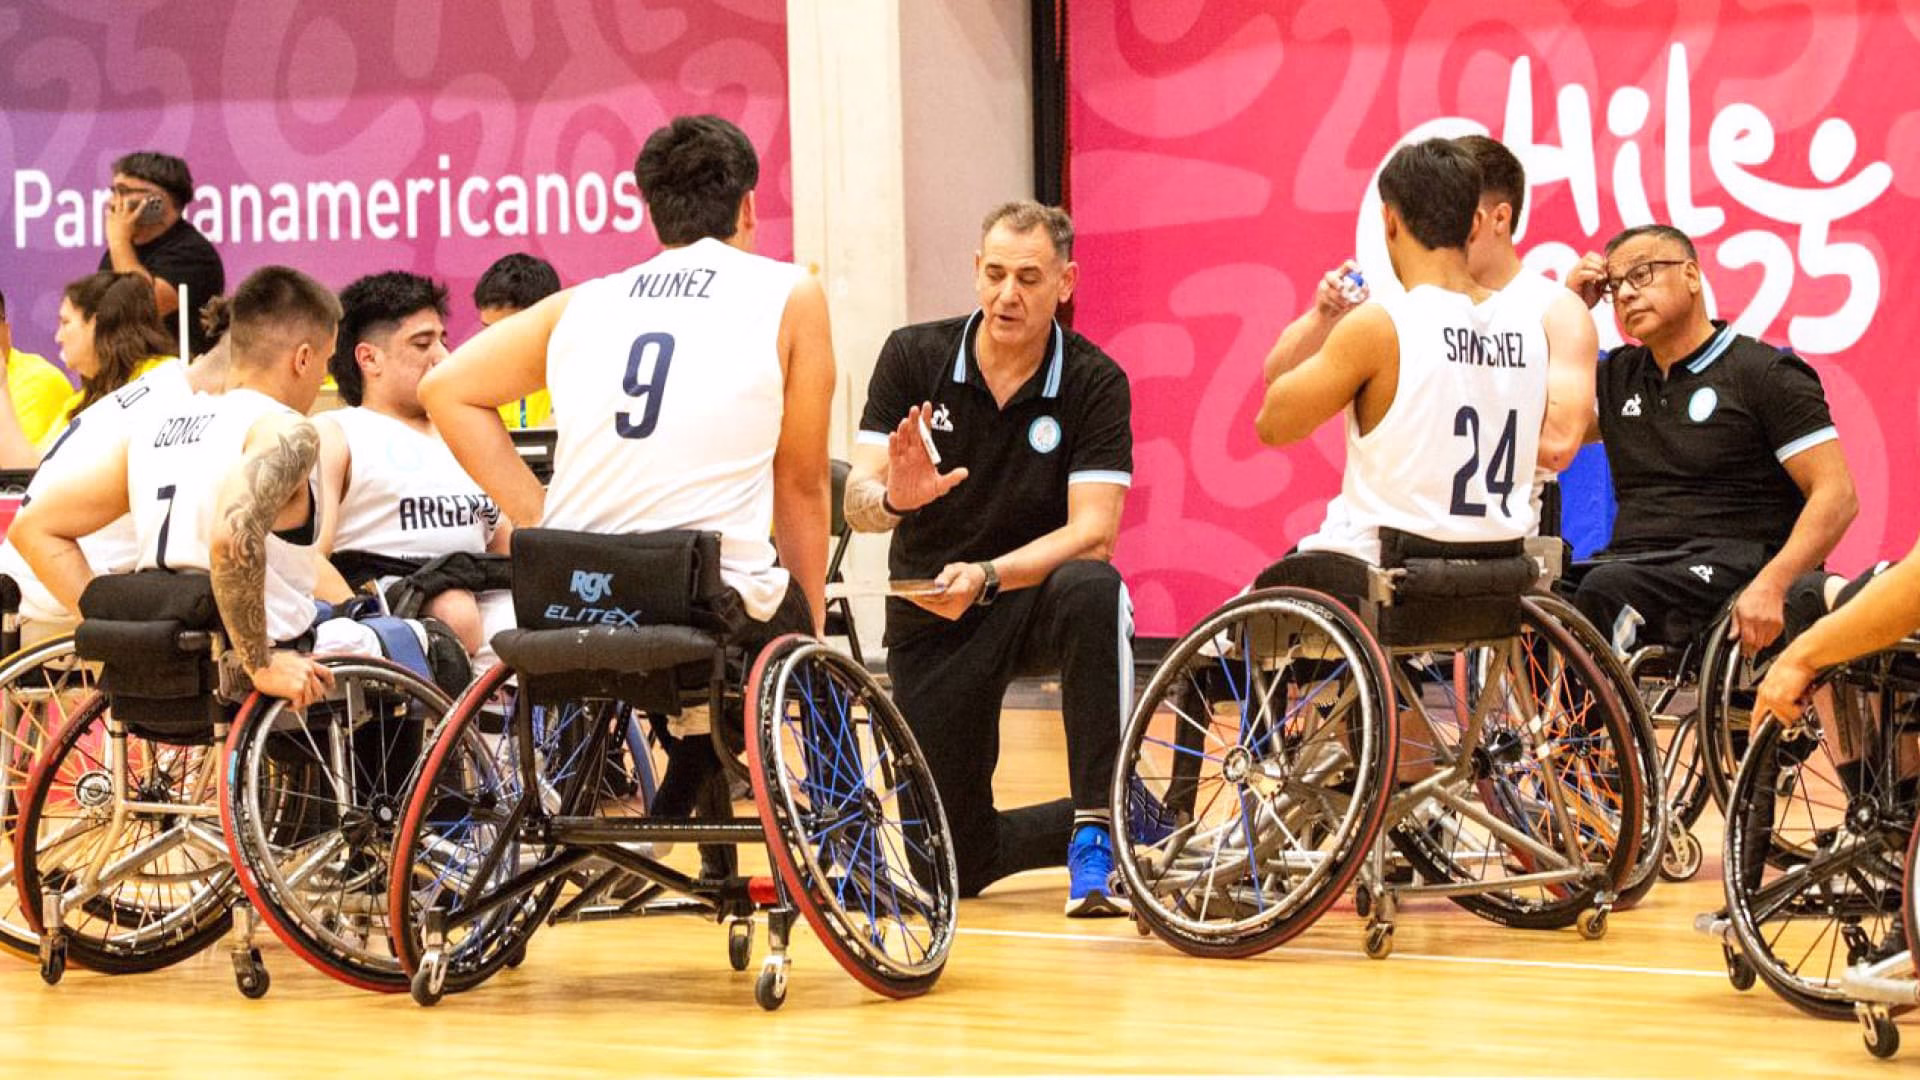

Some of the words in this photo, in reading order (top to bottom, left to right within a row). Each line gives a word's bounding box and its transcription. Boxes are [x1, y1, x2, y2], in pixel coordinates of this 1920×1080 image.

[14, 154, 645, 248] Paranamericanos
[629, 267, 717, 299] NUÑEZ
[1443, 327, 1526, 368] SANCHEZ
[615, 332, 675, 439] 9
[154, 413, 216, 448] GOMEZ
[1450, 405, 1517, 518] 24
[156, 484, 177, 574] 7
[544, 604, 642, 632] ELITEX
